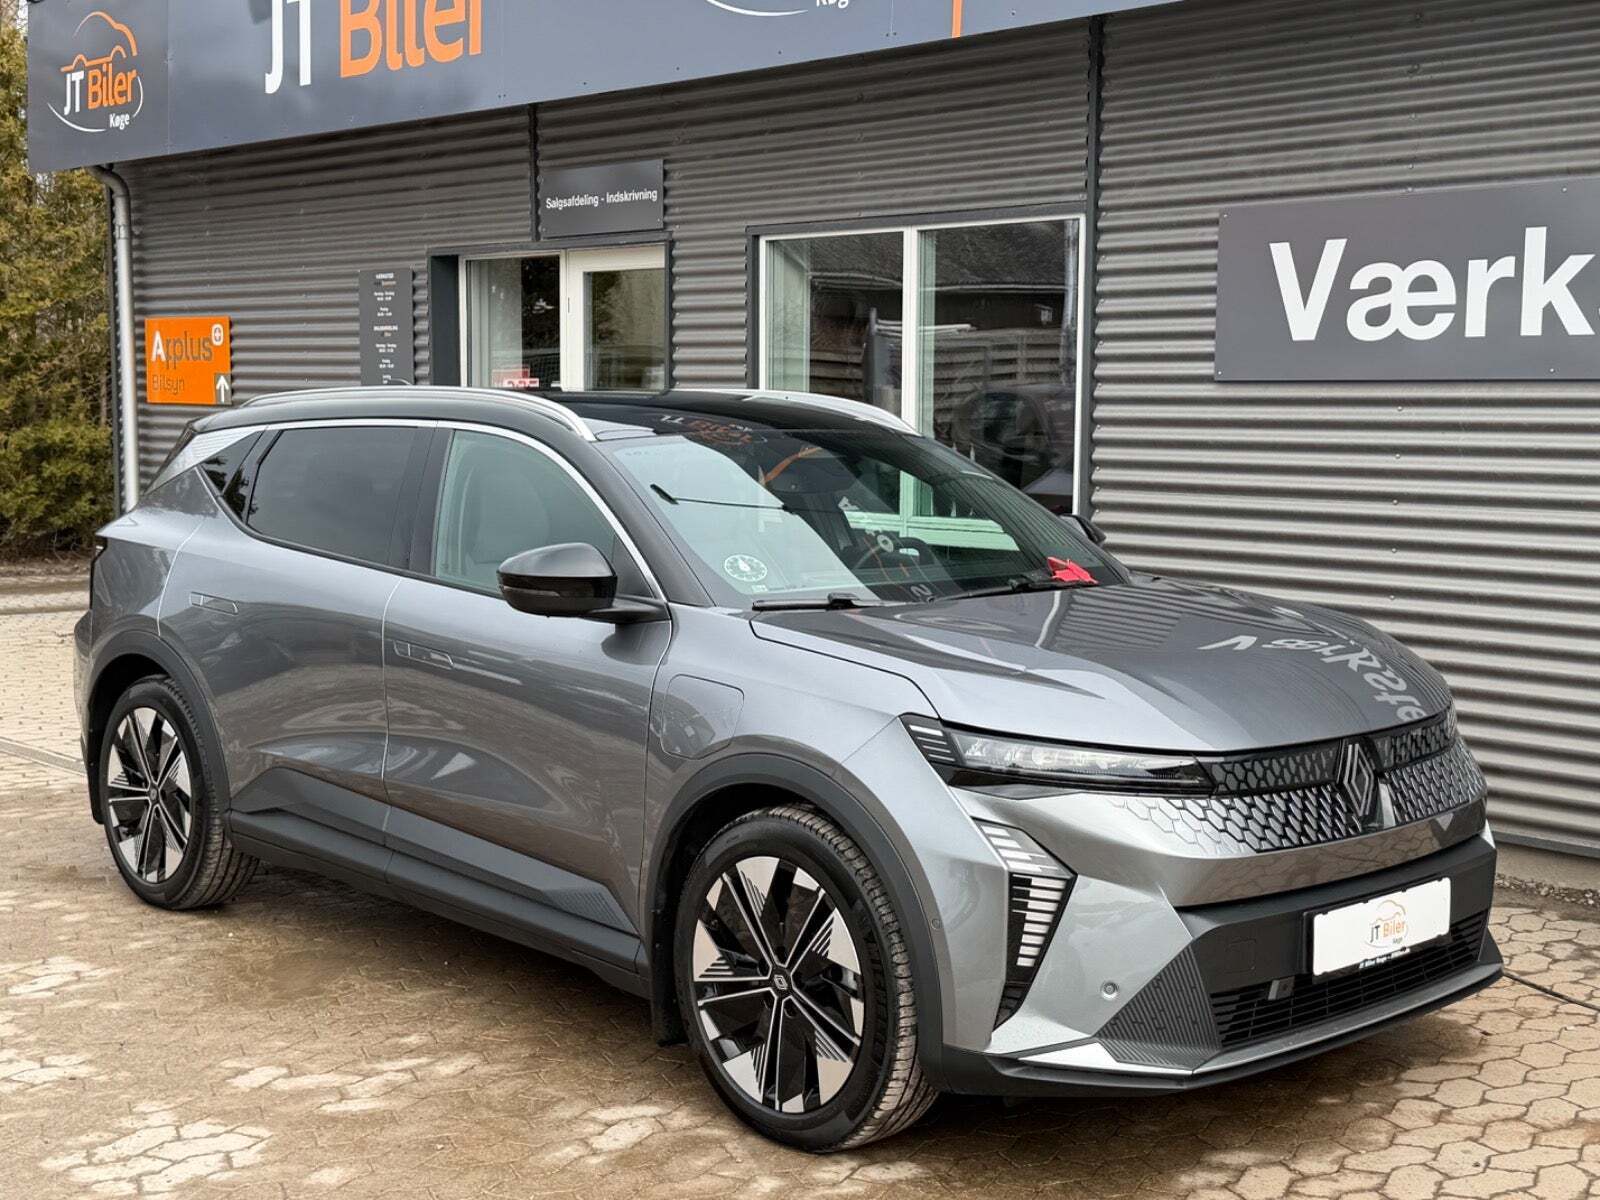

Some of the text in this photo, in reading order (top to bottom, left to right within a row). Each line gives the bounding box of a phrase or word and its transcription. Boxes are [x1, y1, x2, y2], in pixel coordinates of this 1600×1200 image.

[264, 0, 312, 94] JT
[63, 62, 137, 116] JT Biler
[109, 113, 130, 130] Køge
[545, 194, 599, 210] Salgsafdeling
[606, 188, 658, 203] Indskrivning
[1269, 226, 1600, 341] Værk
[152, 374, 185, 396] Bilsyn
[1369, 919, 1406, 943] JT Biler
